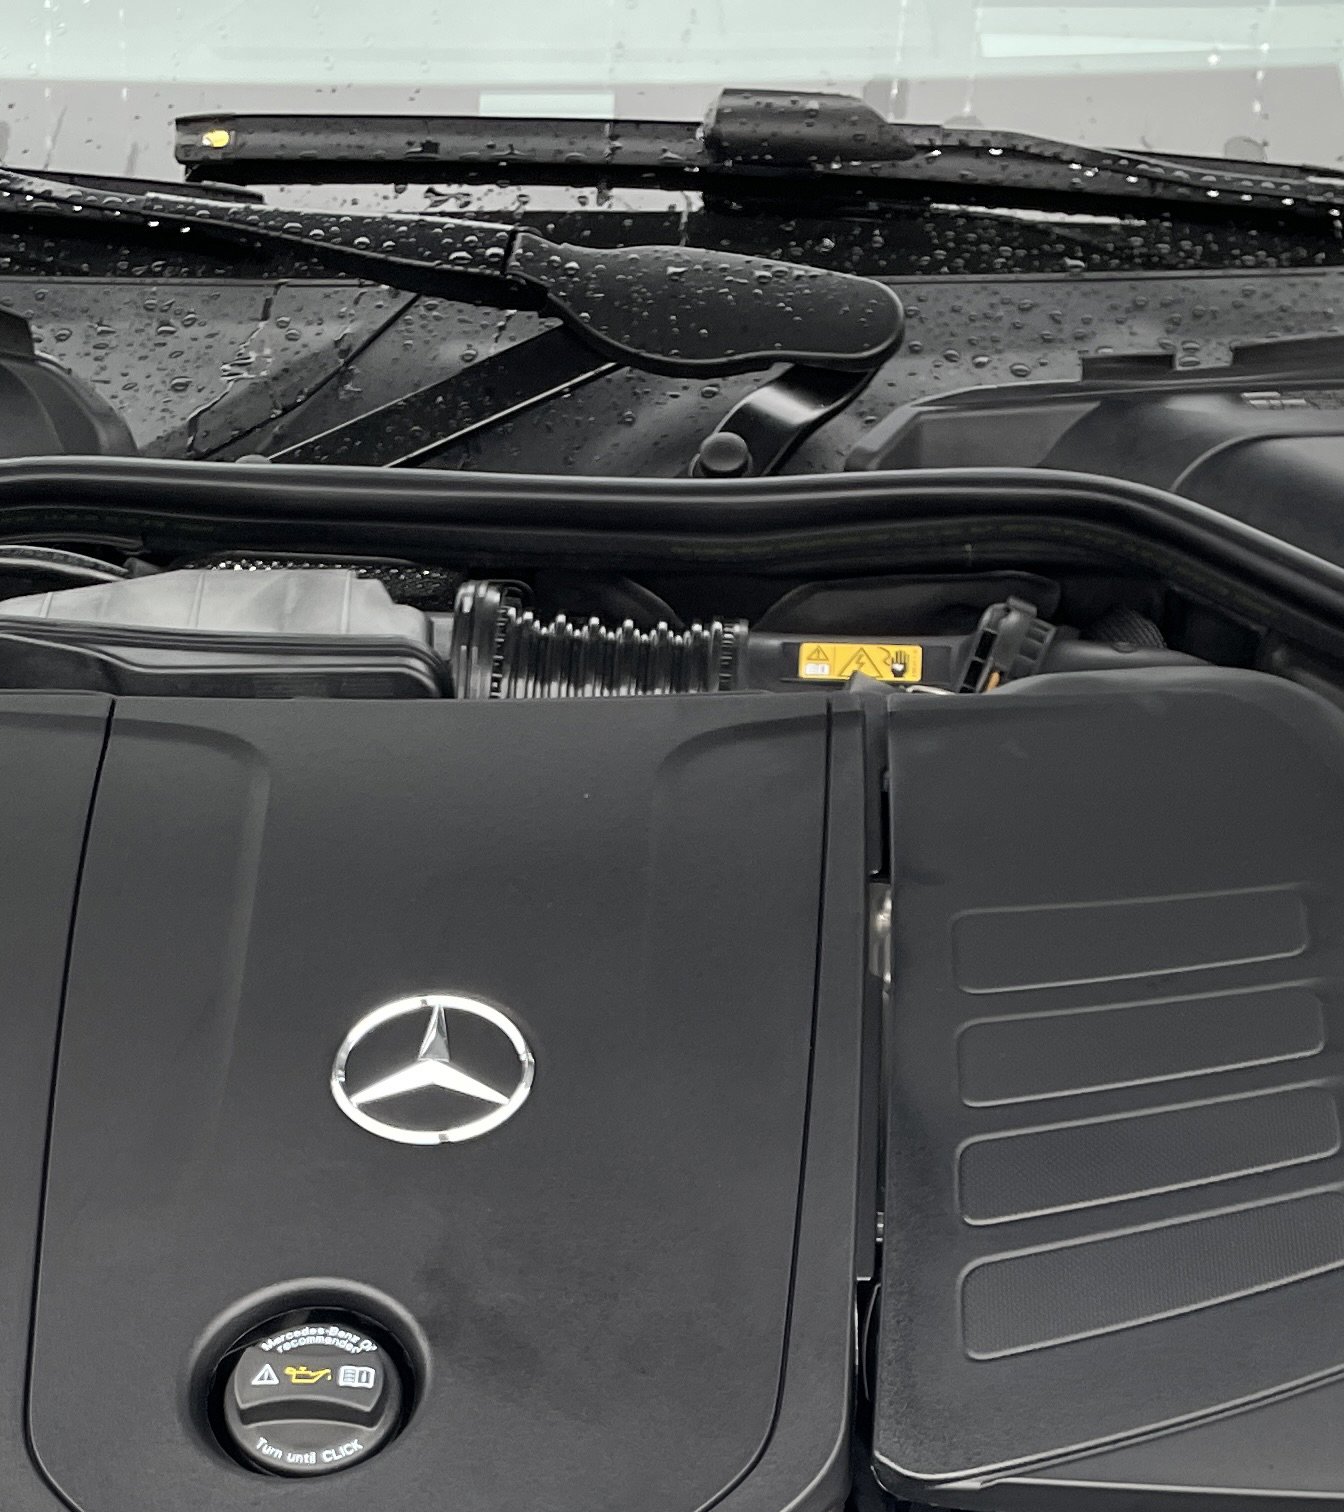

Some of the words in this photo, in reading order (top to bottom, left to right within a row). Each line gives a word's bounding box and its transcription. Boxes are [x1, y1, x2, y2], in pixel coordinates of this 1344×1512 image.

[256, 1437, 283, 1459] Turn
[287, 1450, 317, 1465] until
[322, 1438, 364, 1463] CLICK
